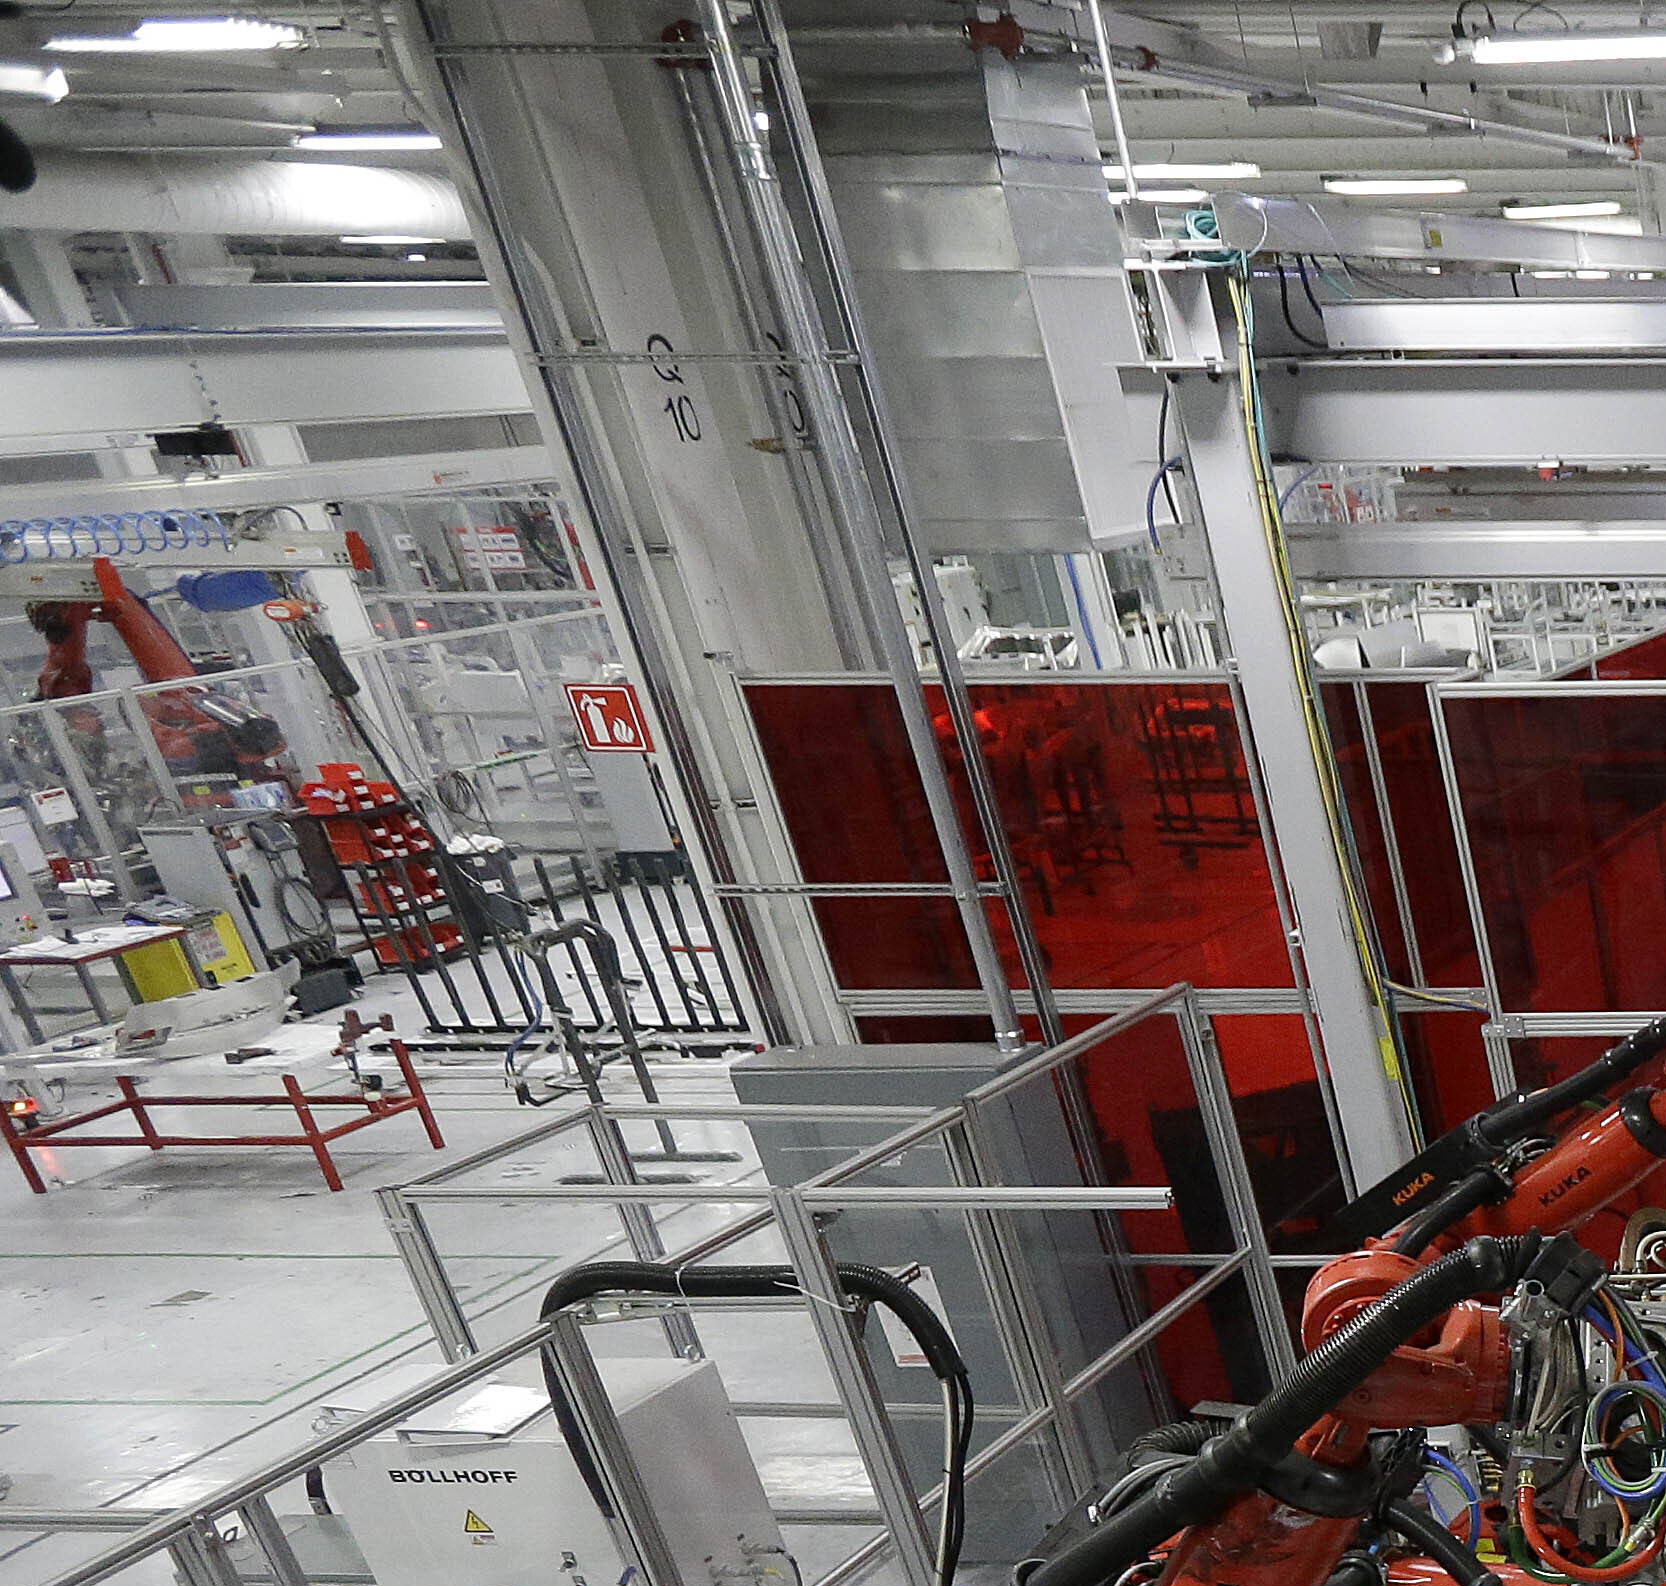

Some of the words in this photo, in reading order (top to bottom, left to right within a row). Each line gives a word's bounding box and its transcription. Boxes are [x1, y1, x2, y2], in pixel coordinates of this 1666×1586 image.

[664, 396, 701, 442] 10
[1393, 1171, 1435, 1205] KUKA
[1538, 1166, 1592, 1206] KUKA
